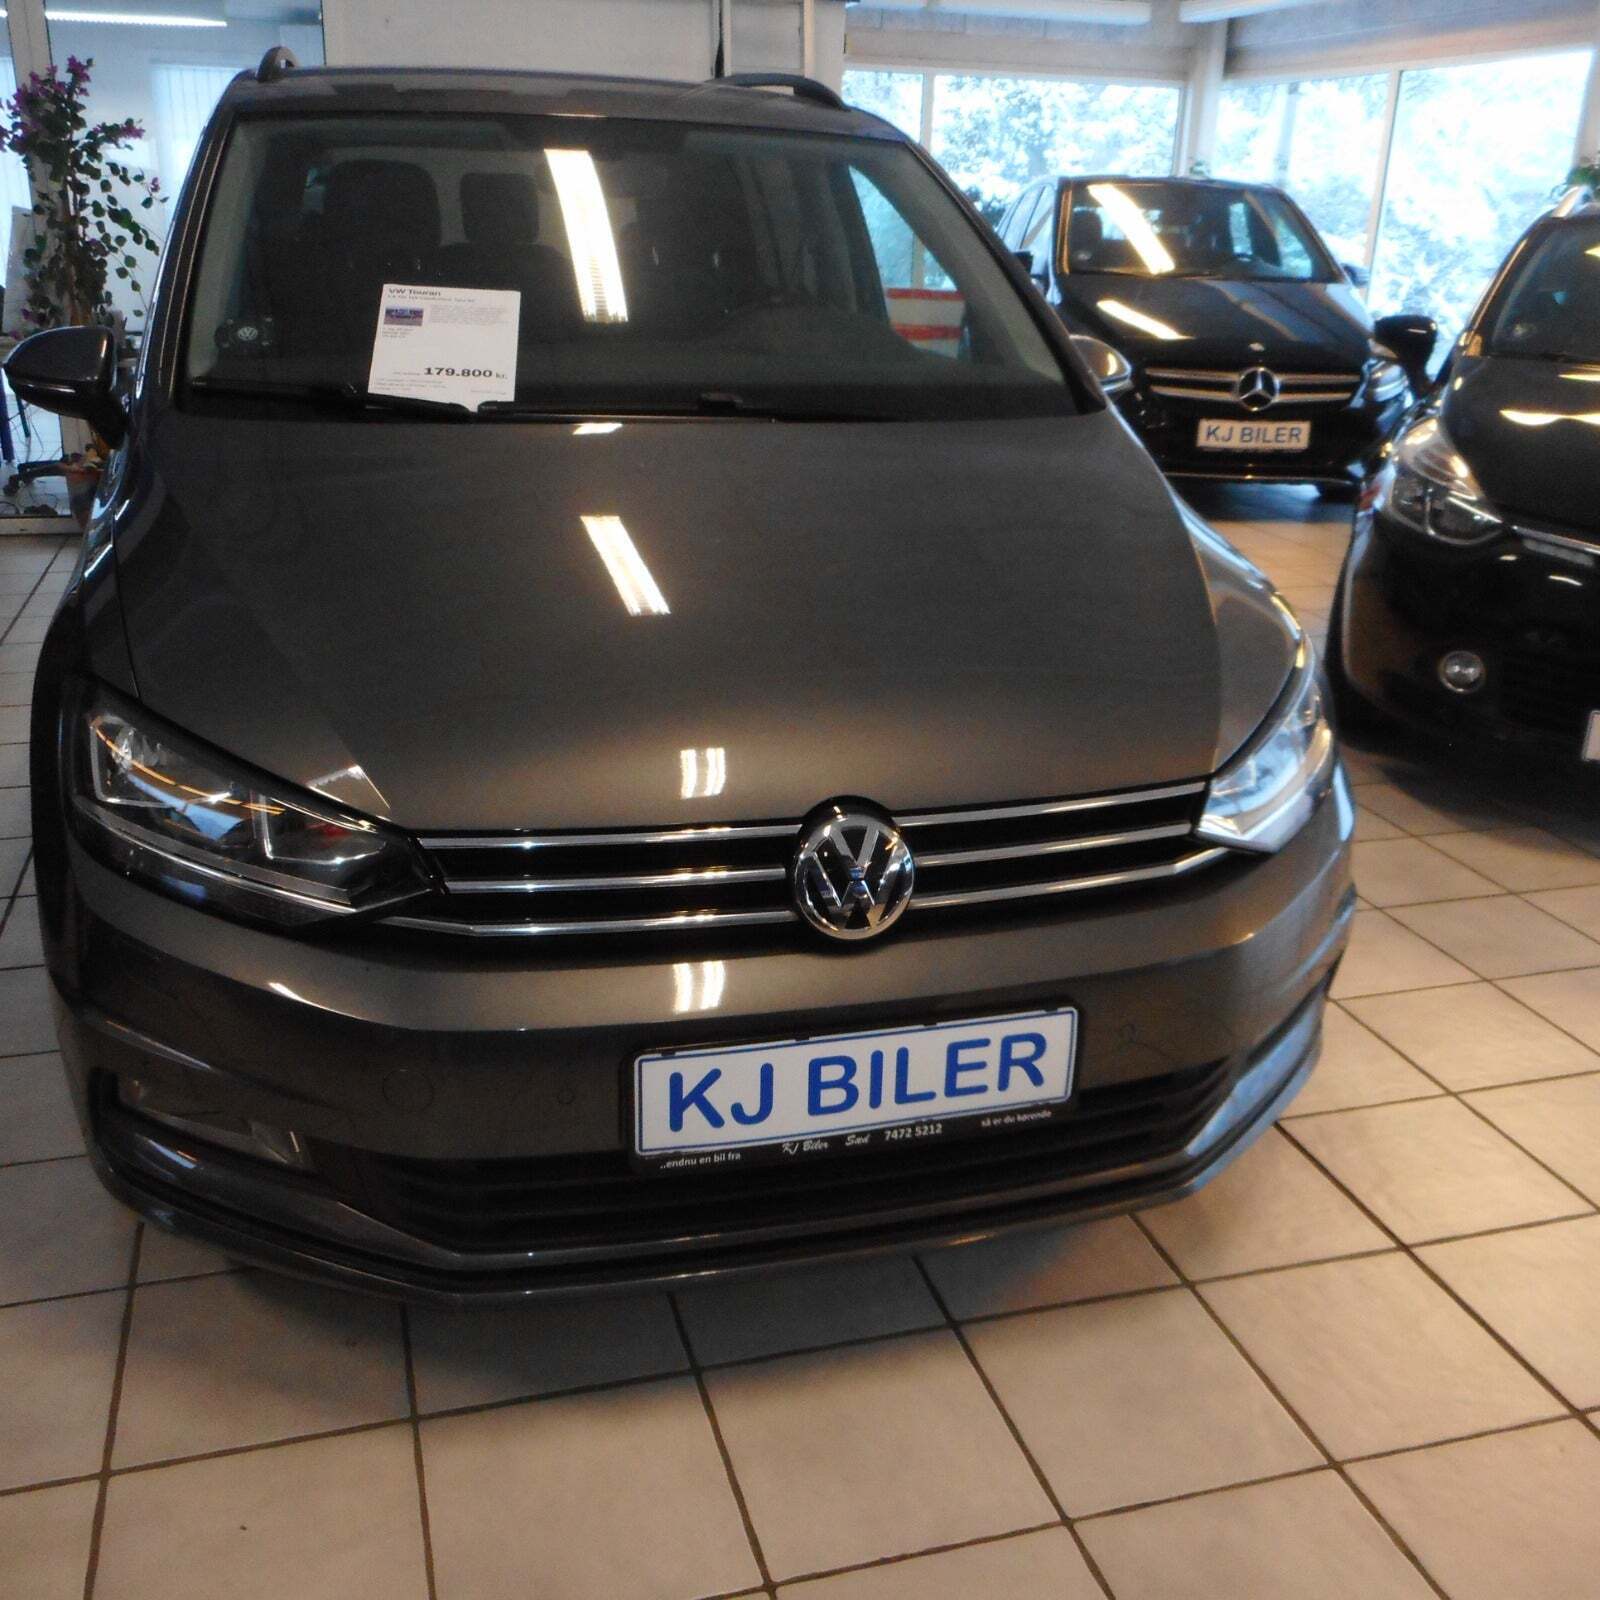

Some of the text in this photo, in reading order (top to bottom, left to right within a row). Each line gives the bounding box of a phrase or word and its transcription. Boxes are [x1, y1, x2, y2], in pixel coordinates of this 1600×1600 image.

[409, 289, 441, 297] Touran
[423, 367, 493, 378] 179.800
[1206, 425, 1302, 443] KJ BILER
[669, 1031, 1048, 1132] KJ BILER
[884, 1123, 943, 1141] 7472 5212
[802, 1139, 829, 1152] Biler
[700, 1157, 711, 1165] en
[714, 1152, 726, 1162] bil
[728, 1152, 741, 1161] fra
